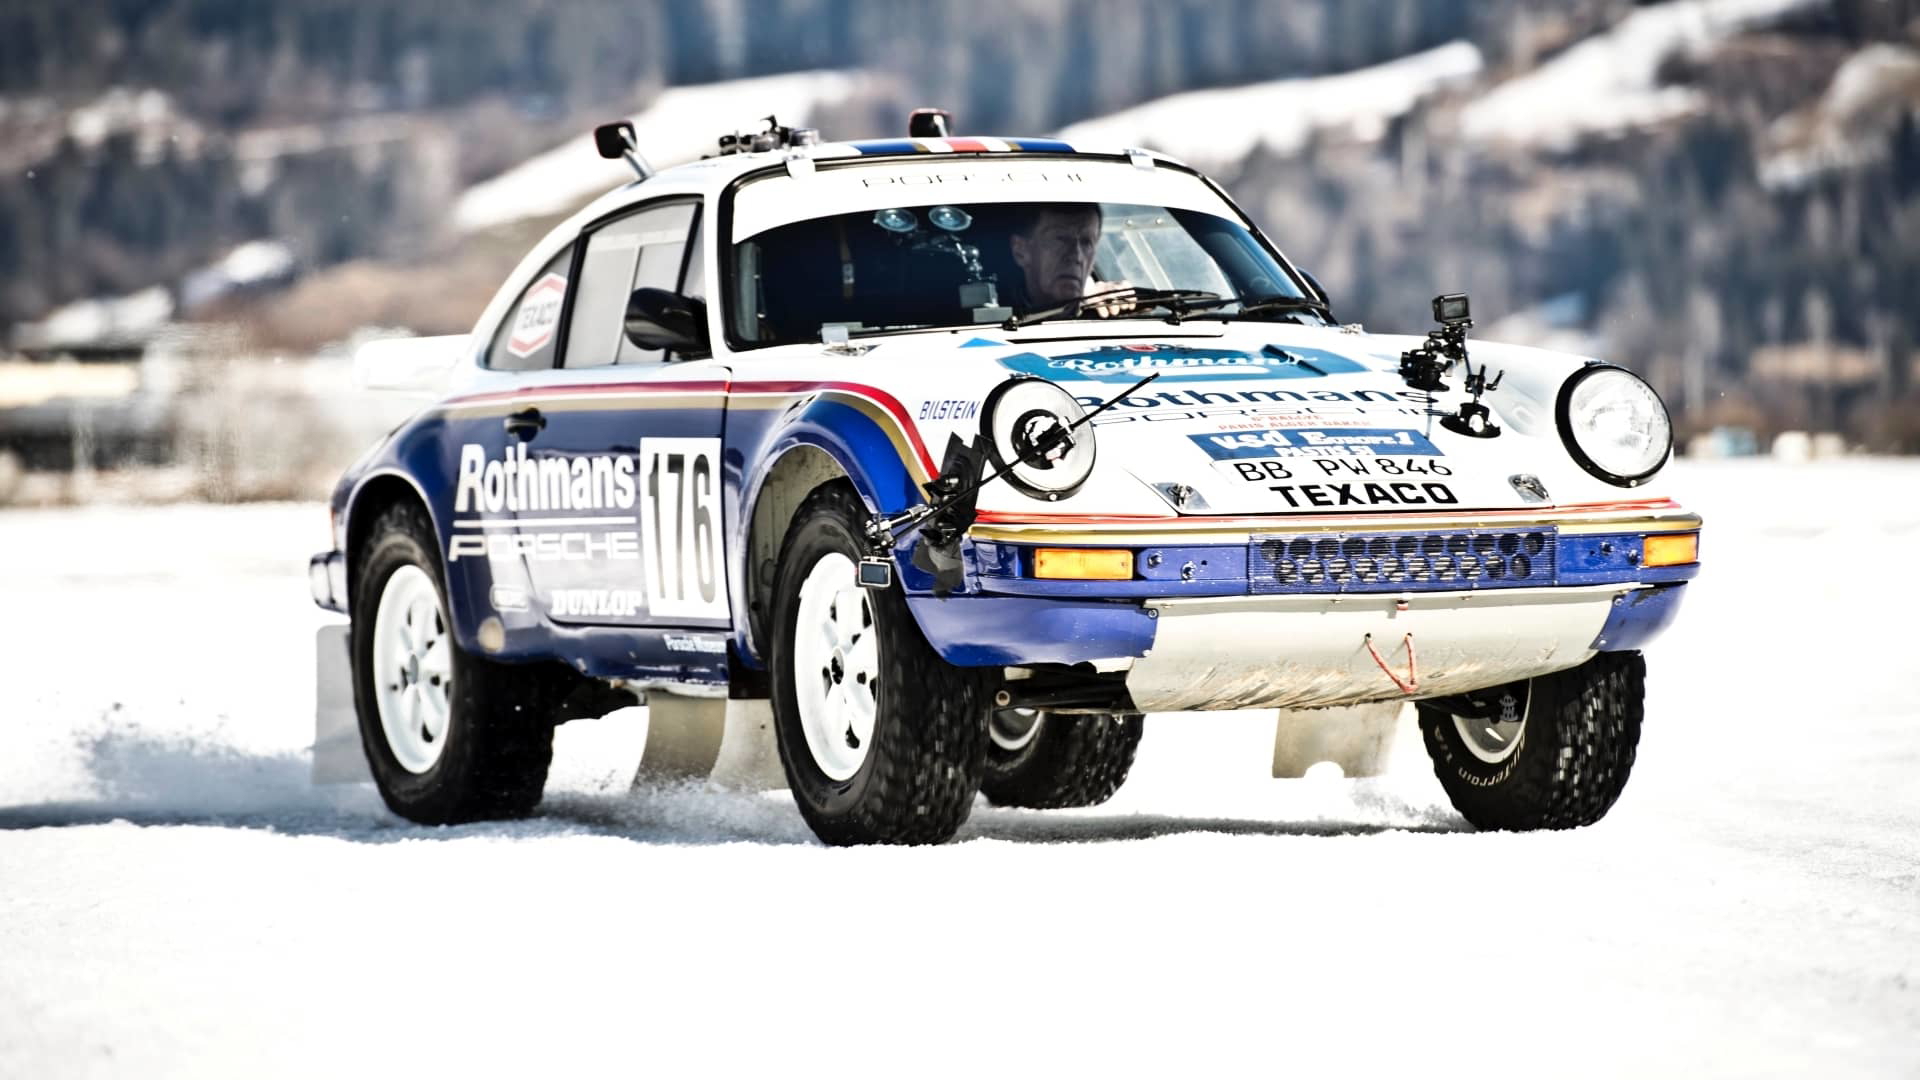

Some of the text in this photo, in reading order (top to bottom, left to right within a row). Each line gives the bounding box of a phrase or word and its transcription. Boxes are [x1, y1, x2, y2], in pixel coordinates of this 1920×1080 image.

[919, 400, 980, 420] BILSTEIN
[454, 442, 636, 513] Rothmans
[1233, 458, 1453, 482] BB PW 846
[1269, 482, 1459, 507] TEXACO
[648, 452, 716, 604] 176
[448, 531, 640, 562] PORSCHE
[551, 589, 643, 616] DUNLOP
